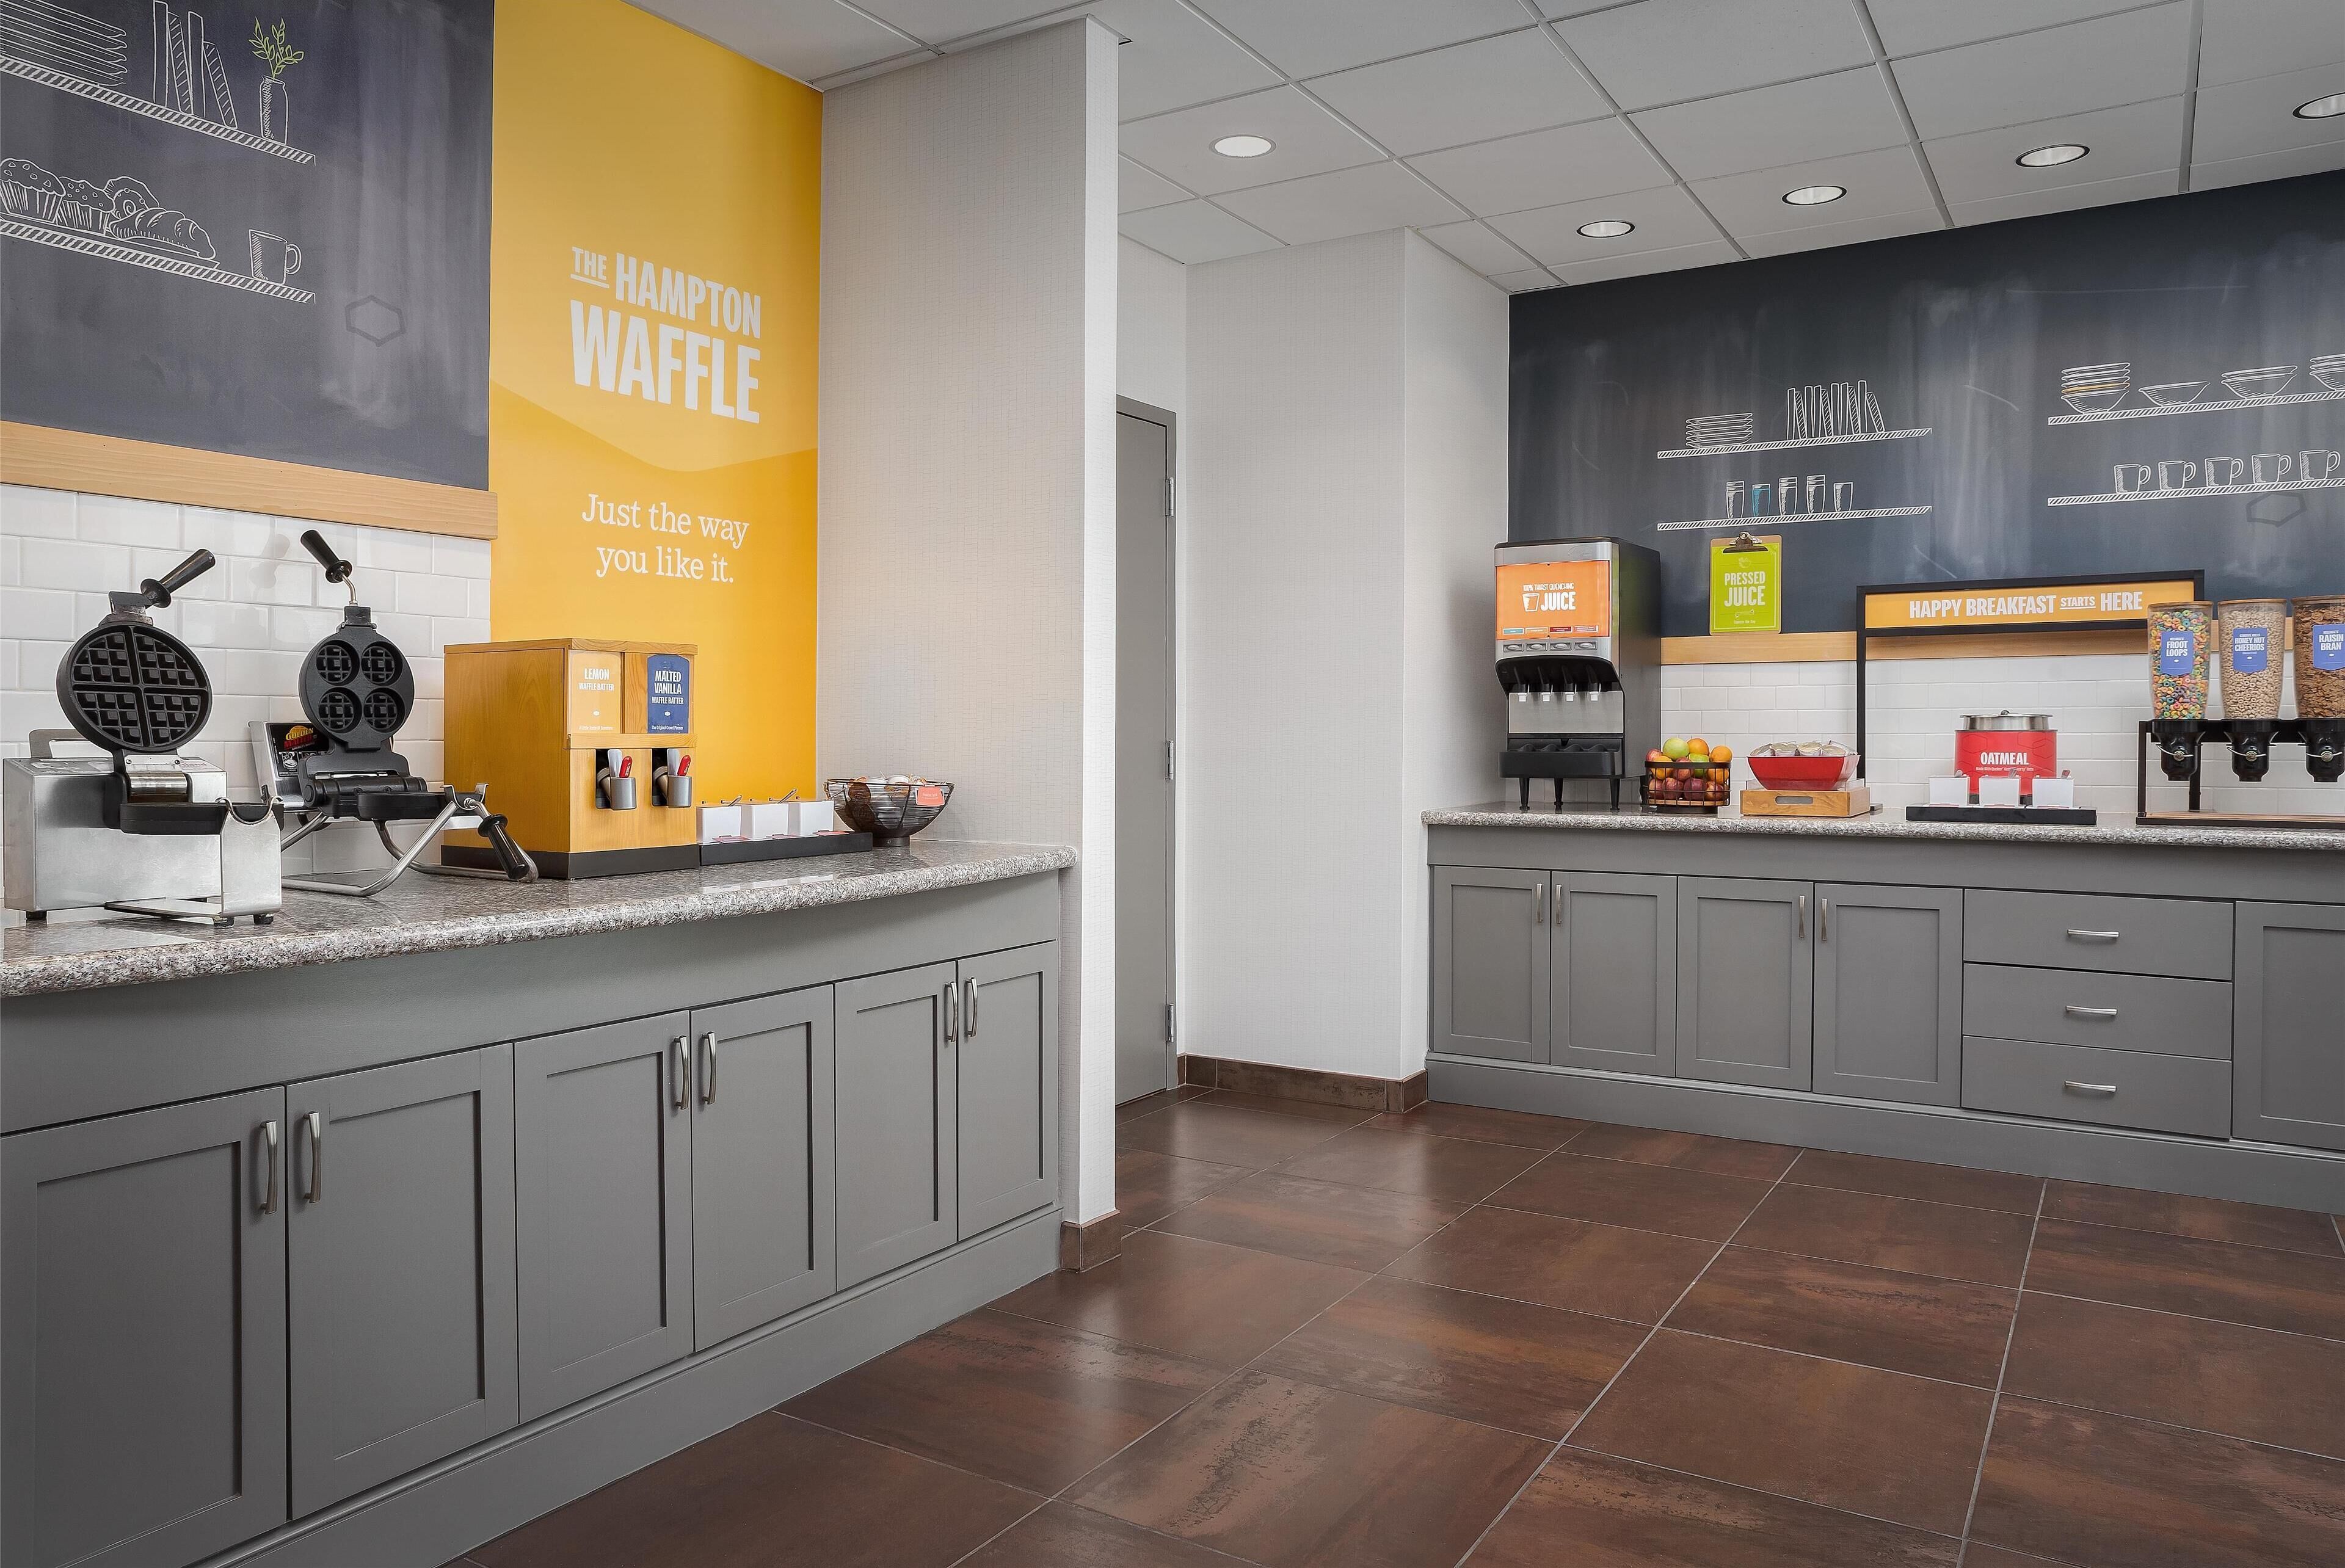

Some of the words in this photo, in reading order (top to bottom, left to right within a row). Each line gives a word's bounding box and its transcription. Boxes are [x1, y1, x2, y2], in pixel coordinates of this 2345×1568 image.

[572, 246, 608, 280] THE
[616, 252, 761, 339] HAMPTON
[570, 299, 760, 424] WAFFLE
[581, 493, 641, 529] Just
[649, 501, 691, 535] the
[698, 515, 750, 550] way
[596, 546, 649, 578] you
[655, 546, 704, 580] like
[710, 552, 734, 583] it.
[1724, 571, 1766, 586] PRESSED
[1540, 591, 1576, 611] JUICE
[1724, 586, 1766, 607] JUICE
[1909, 598, 1962, 619] HAPPY
[1966, 595, 2057, 617] BREAKFAST
[2060, 596, 2096, 607] STARTS
[2100, 591, 2143, 611] HERE
[2319, 634, 2344, 642] RAISIN
[2166, 648, 2188, 657] LOOPS
[2321, 642, 2341, 651] BRAN
[584, 667, 609, 680] LEMON
[655, 670, 682, 682] MALTED
[579, 682, 597, 691] WAFFLE
[654, 683, 682, 694] VANILLA
[1980, 752, 2029, 765] OATMEAL
